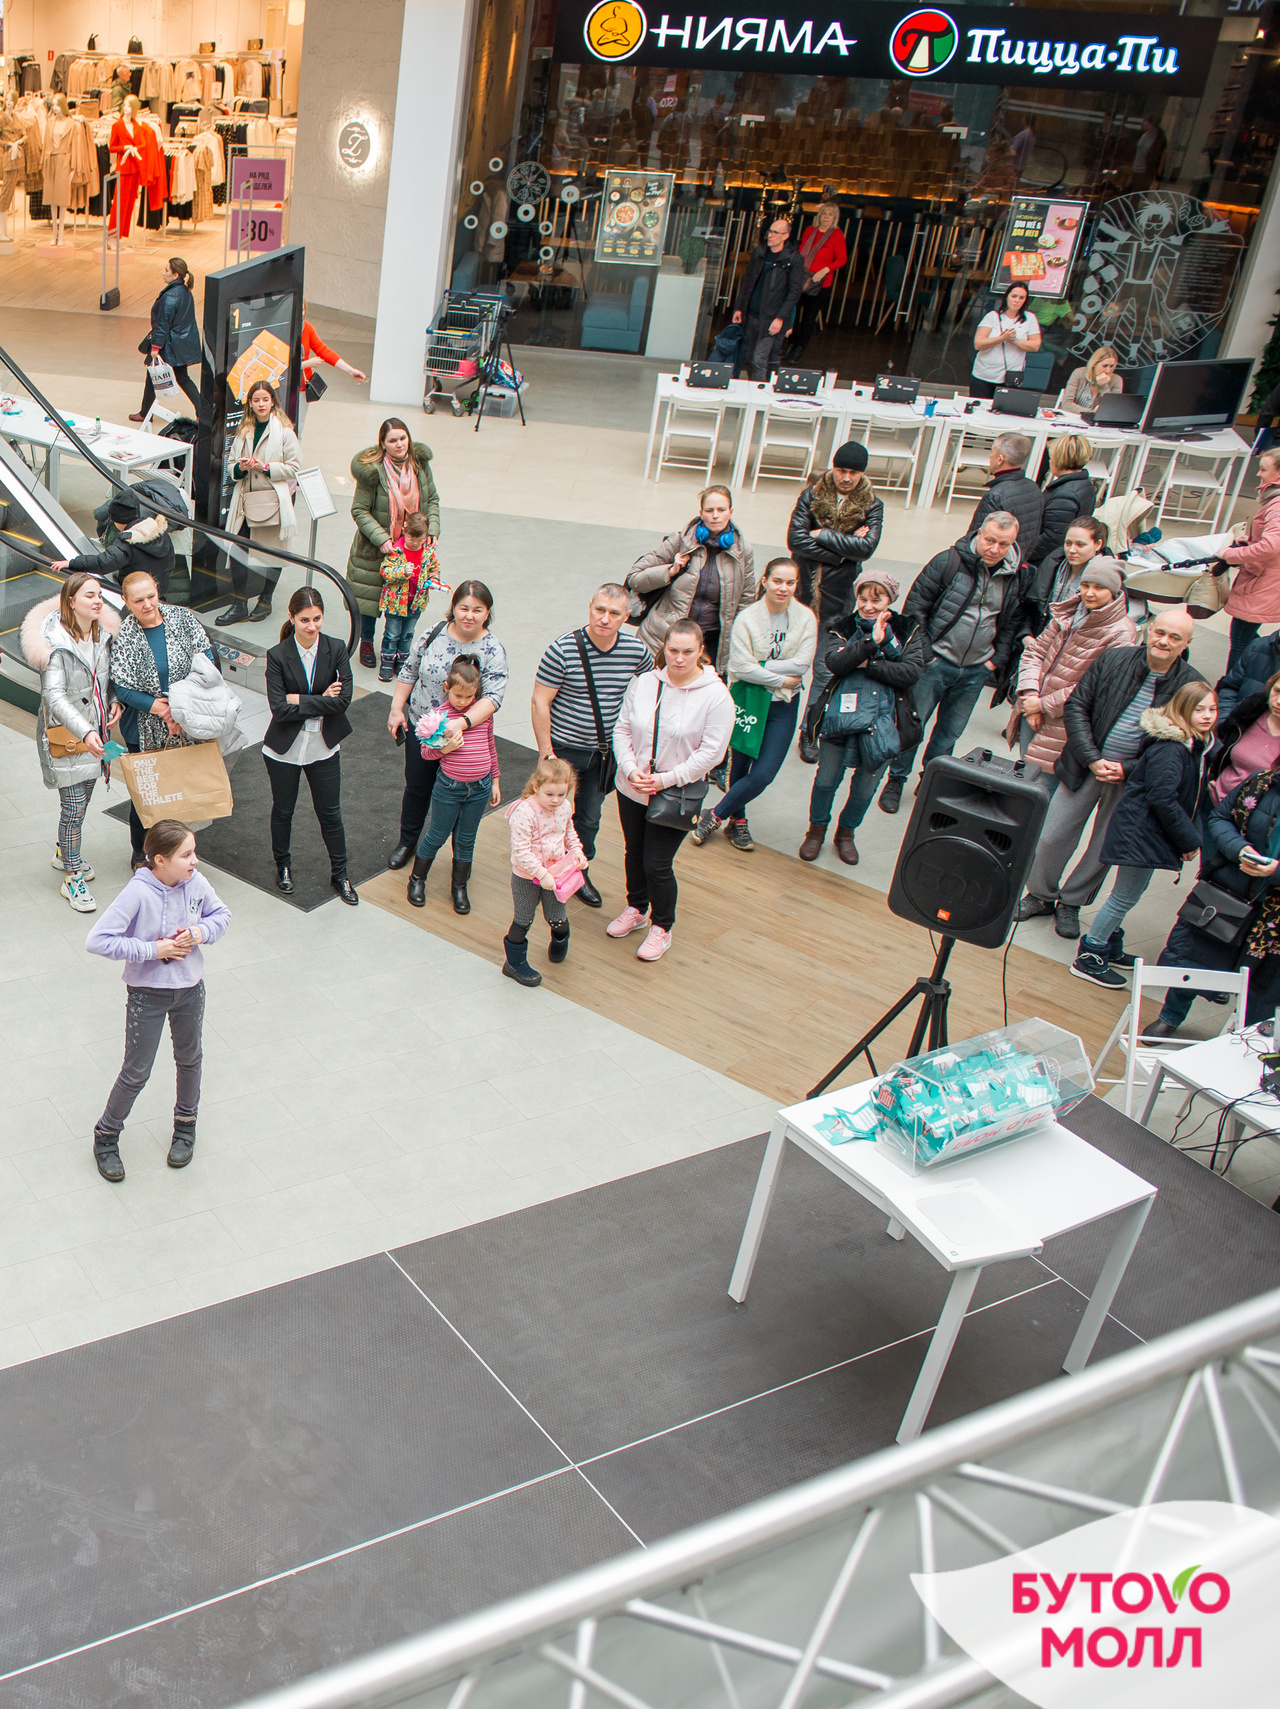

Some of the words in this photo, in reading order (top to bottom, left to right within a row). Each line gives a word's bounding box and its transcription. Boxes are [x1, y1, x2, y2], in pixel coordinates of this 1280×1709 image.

[650, 15, 858, 56] НИЯМА
[133, 757, 157, 769] ONLY
[134, 767, 154, 776] THE
[136, 773, 160, 784] BEST
[138, 782, 157, 792] FOR
[139, 789, 158, 800] THE
[142, 792, 183, 806] ATHLETE
